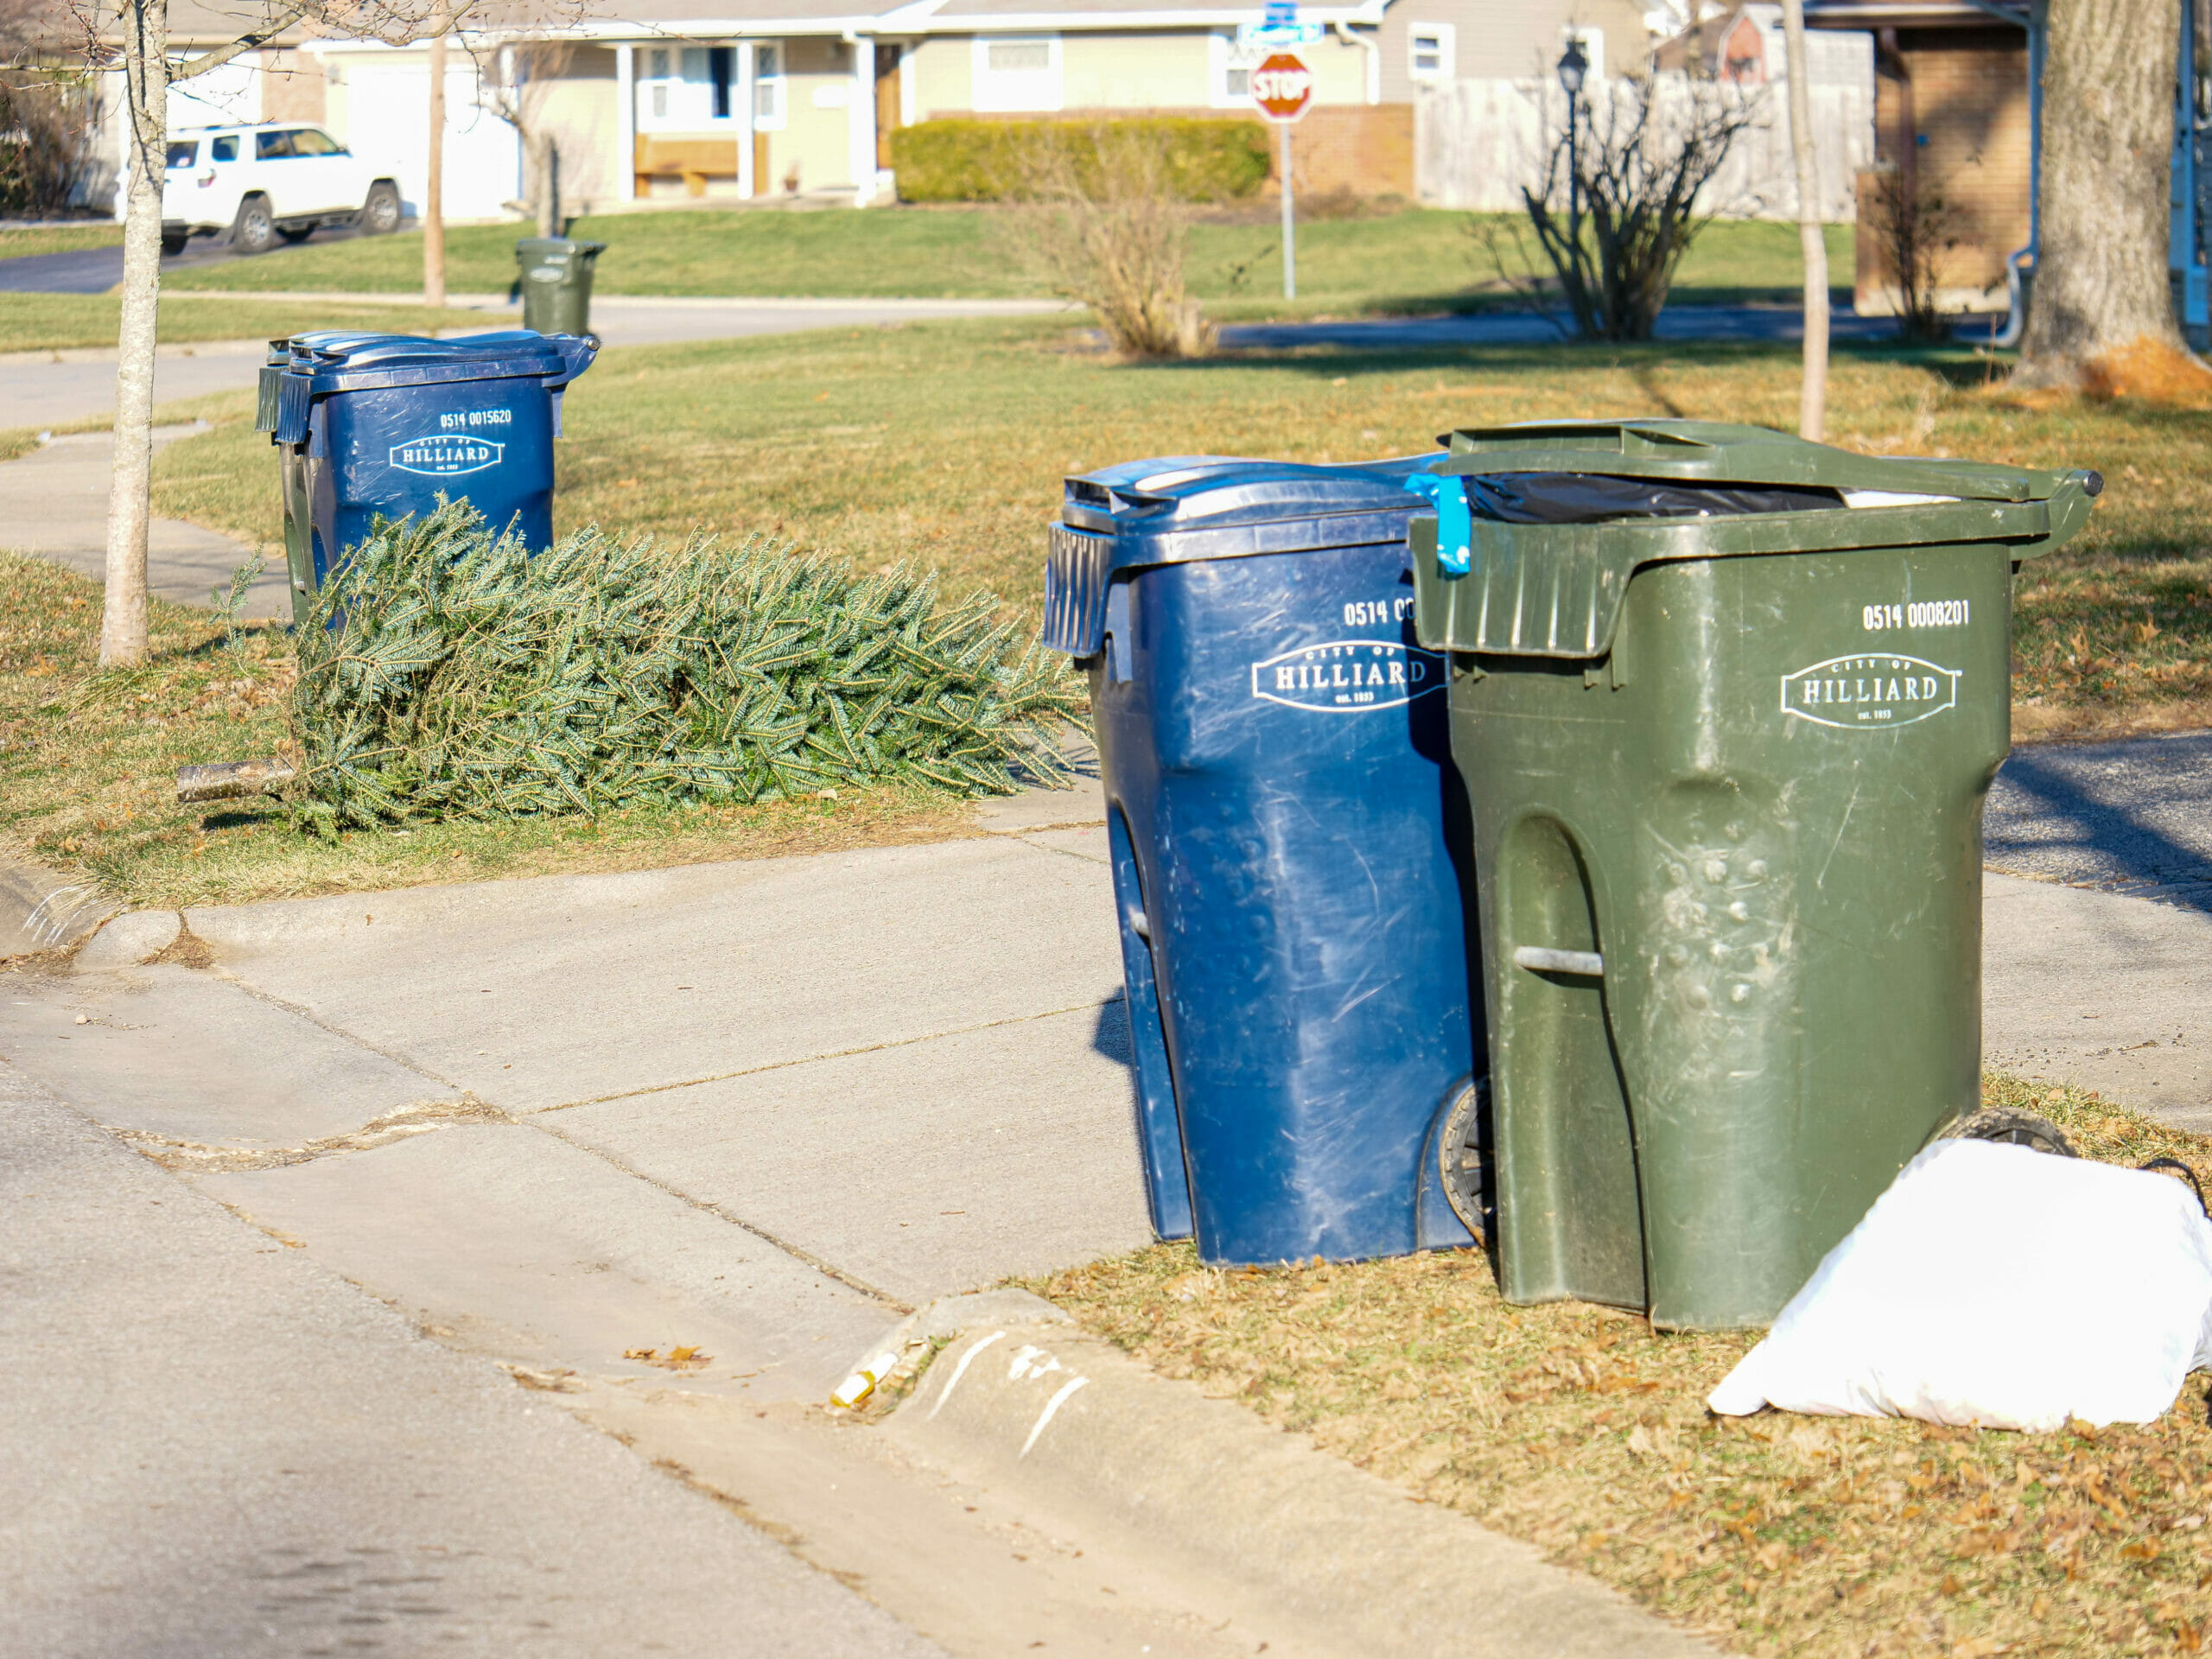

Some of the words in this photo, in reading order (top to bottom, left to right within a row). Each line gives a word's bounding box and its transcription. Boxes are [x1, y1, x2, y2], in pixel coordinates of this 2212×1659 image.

[1254, 71, 1311, 101] STOP
[441, 413, 467, 429] 0514
[468, 410, 512, 426] 0015620
[402, 447, 490, 463] HILLIARD
[1344, 600, 1389, 626] 0514
[1862, 603, 1903, 631] 0514
[1907, 600, 1970, 628] 0008201
[1305, 645, 1356, 660] CITY
[1372, 645, 1396, 658] OF
[1830, 658, 1878, 673] CITY
[1891, 659, 1912, 671] OF
[1274, 661, 1427, 690] HILLIARD
[1802, 676, 1938, 704] HILLIARD
